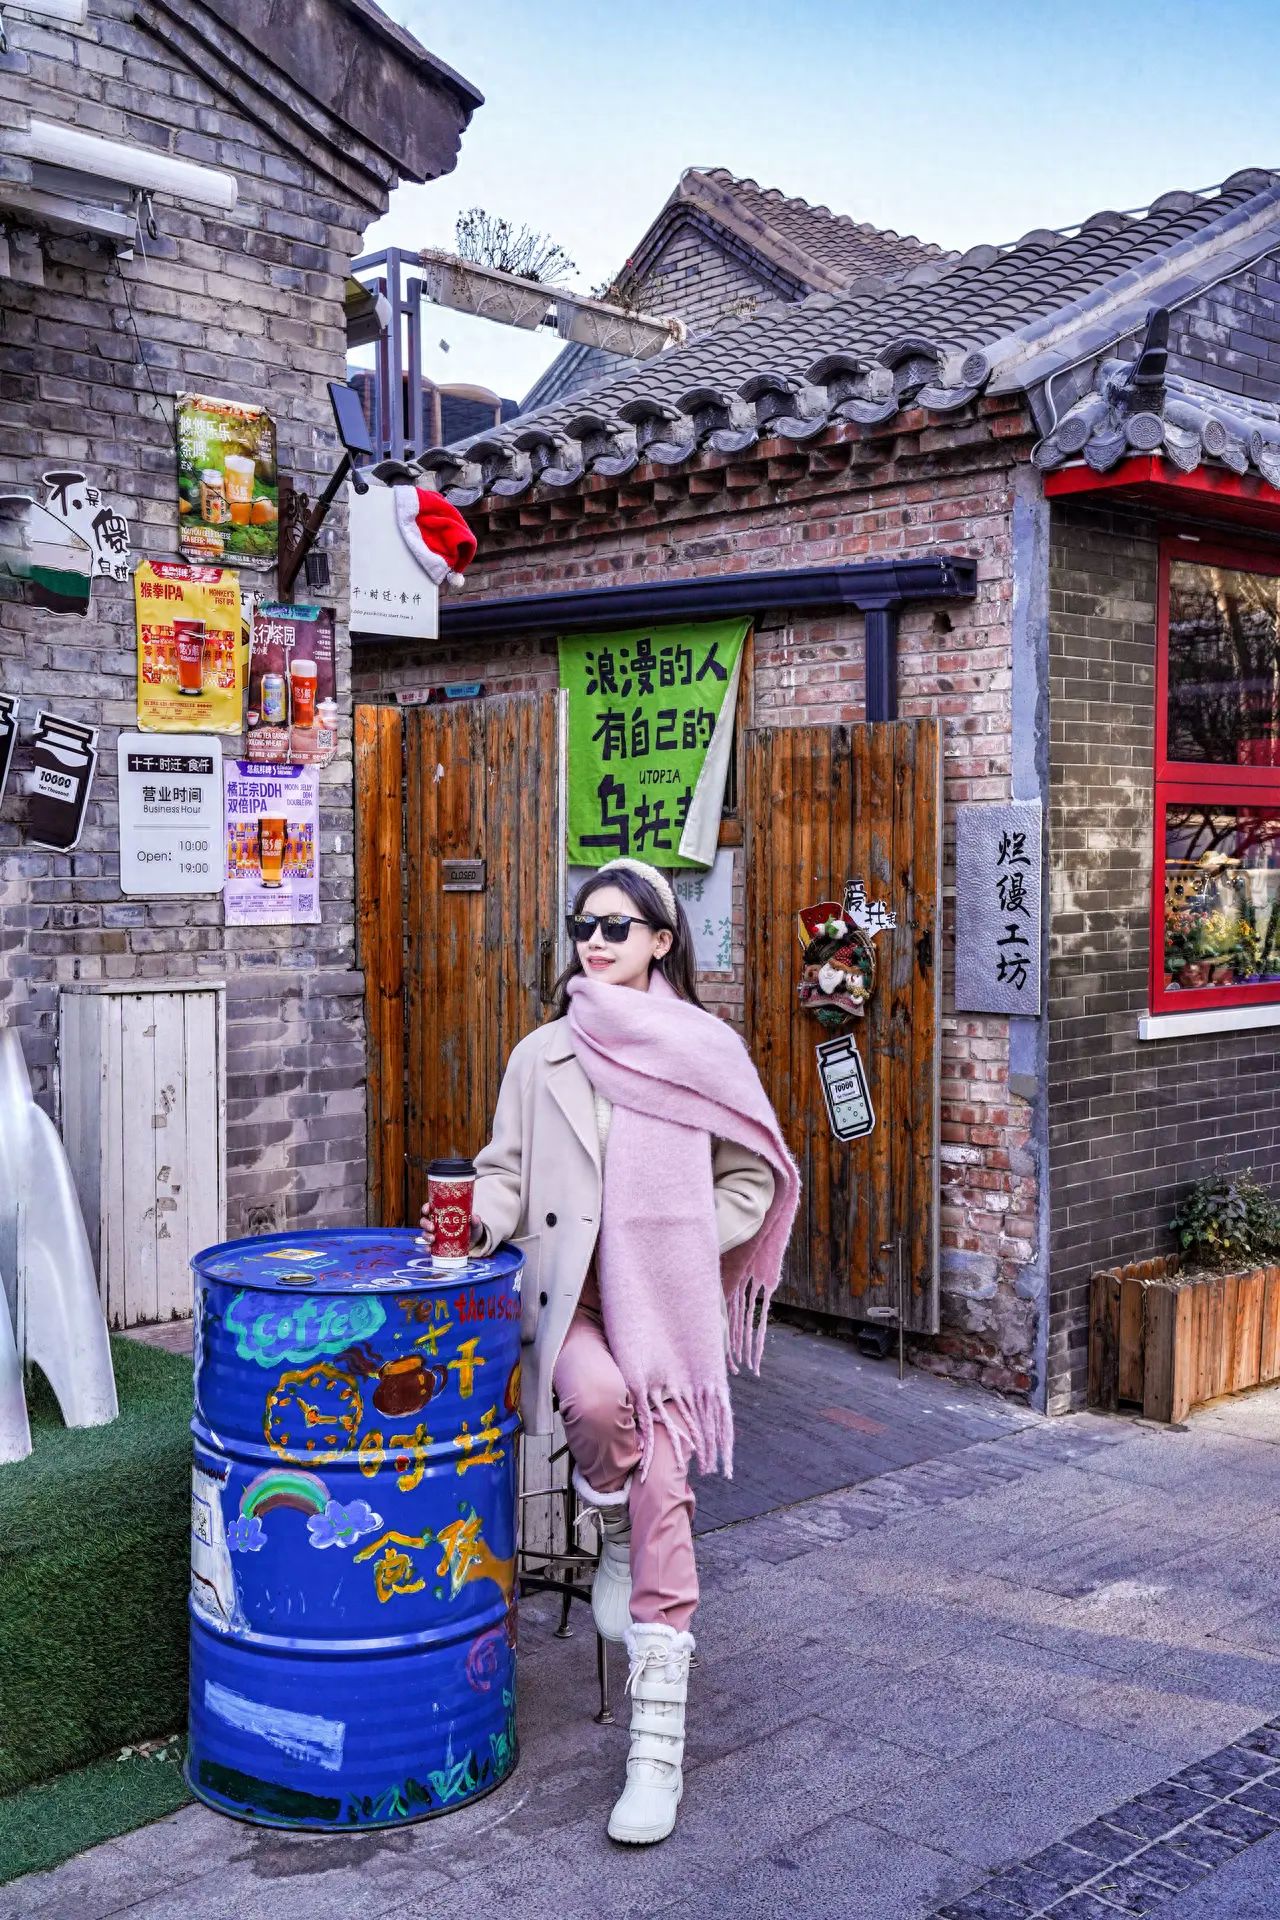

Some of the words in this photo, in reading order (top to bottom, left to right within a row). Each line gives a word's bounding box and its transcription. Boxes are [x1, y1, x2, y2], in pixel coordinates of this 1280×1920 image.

[140, 582, 184, 601] 猴拳IPA
[208, 588, 235, 598] MONKEY'S
[585, 638, 728, 698] 浪漫的人
[591, 706, 717, 761] 有自己的
[41, 771, 71, 788] 10000
[639, 769, 681, 785] UTOPIA
[142, 786, 202, 803] 营业时间
[227, 781, 282, 798] 橘正宗DDH
[143, 804, 180, 813] Business
[181, 805, 201, 814] Hour
[227, 798, 268, 813] 双倍IPA
[178, 840, 208, 851] 10:00
[136, 850, 172, 862] Open:
[179, 863, 209, 874] 19:00
[451, 871, 477, 880] CLOSED
[835, 1080, 854, 1093] 10000
